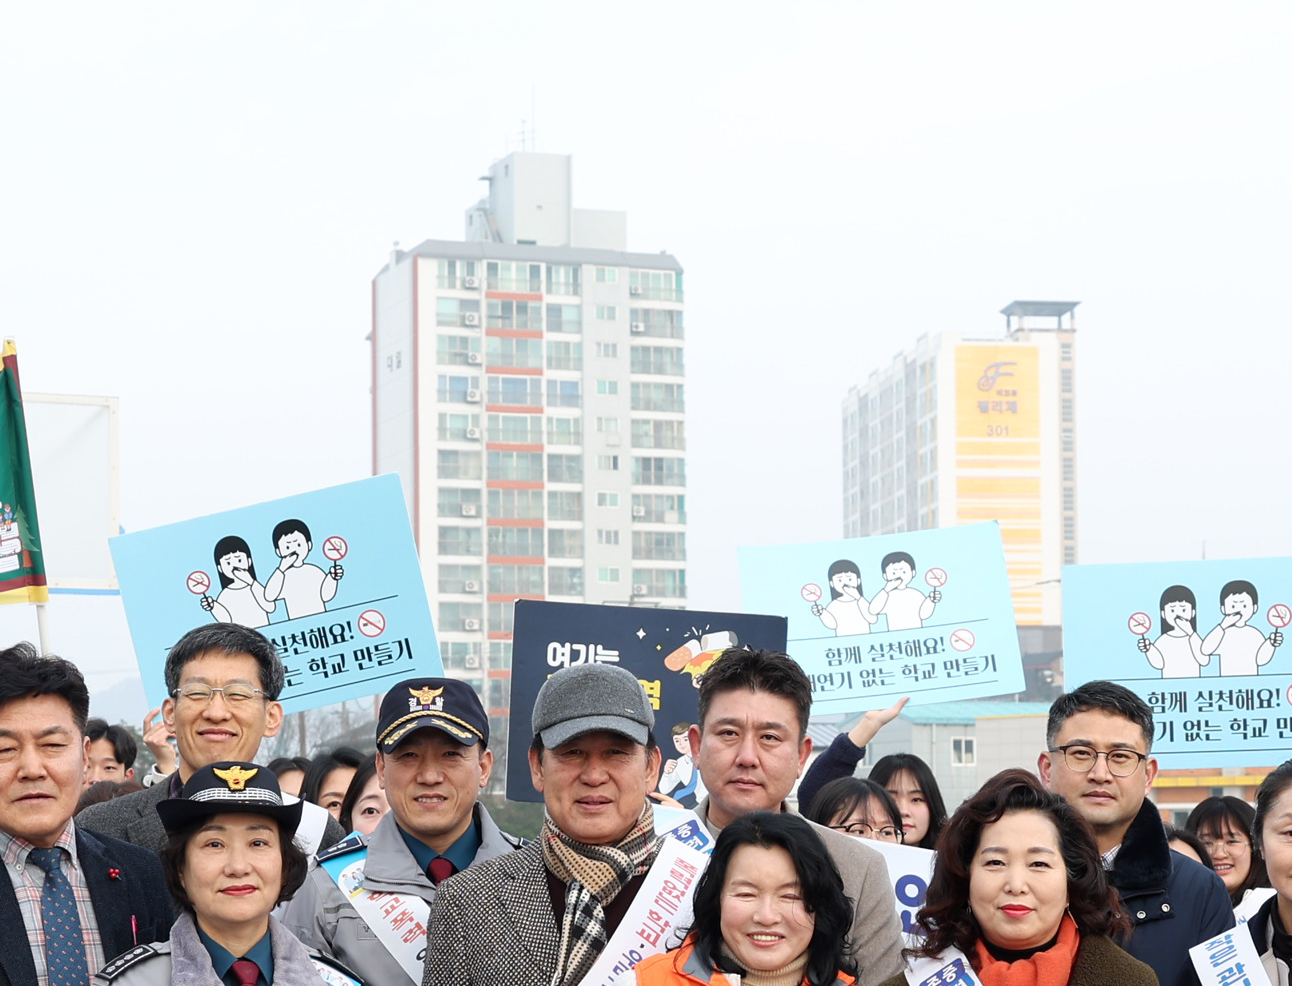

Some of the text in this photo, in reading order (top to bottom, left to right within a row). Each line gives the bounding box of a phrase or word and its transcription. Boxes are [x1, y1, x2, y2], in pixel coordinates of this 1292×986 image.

[284, 638, 414, 687] 는 학교 만들기
[546, 641, 621, 667] 여기는
[824, 635, 947, 664] 함께 실천해요!
[859, 669, 896, 690] 없는
[901, 662, 938, 683] 학교
[943, 654, 998, 679] 만들기
[1146, 687, 1282, 715] 함께 실천해요!
[1183, 720, 1223, 743] 없는
[1229, 717, 1269, 740] 학교
